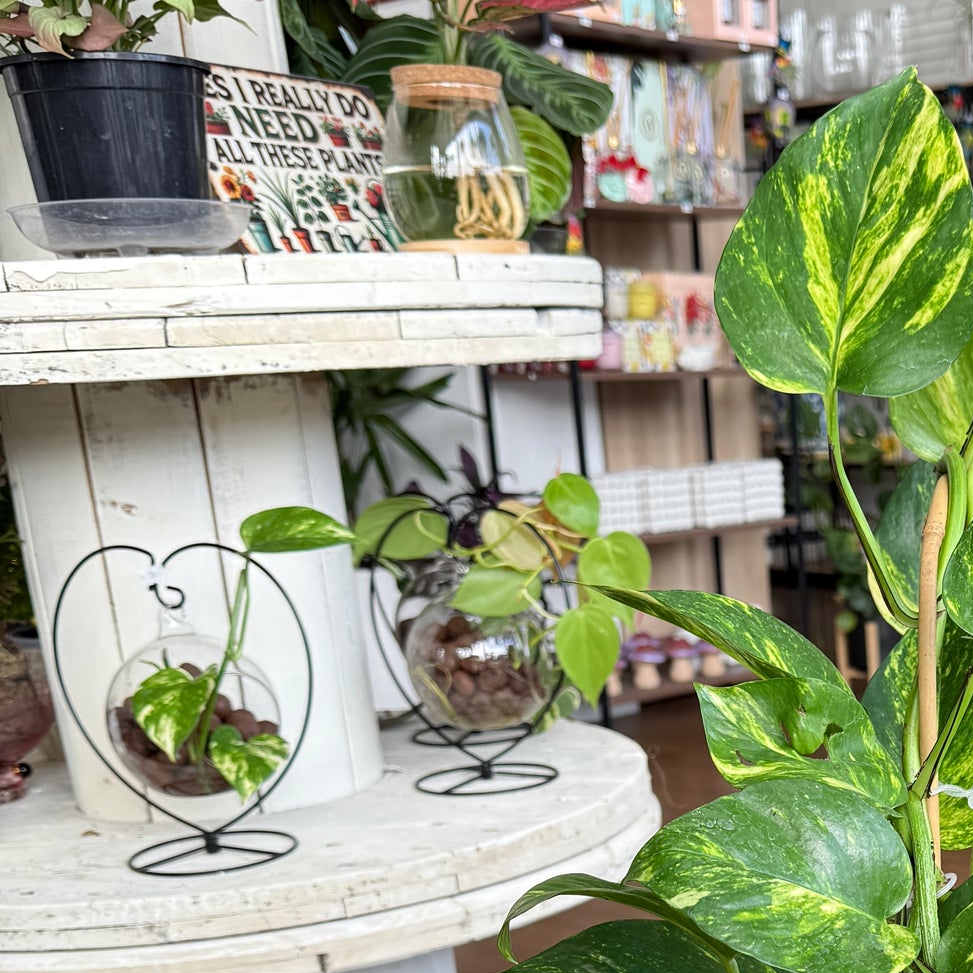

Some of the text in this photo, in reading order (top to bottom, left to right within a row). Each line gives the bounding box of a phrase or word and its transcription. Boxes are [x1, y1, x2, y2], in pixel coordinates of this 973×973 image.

[232, 76, 250, 104] I
[248, 79, 333, 115] REALLY
[334, 92, 370, 120] DO
[229, 105, 320, 143] NEED
[213, 138, 255, 164] ALL
[250, 141, 319, 170] THESE
